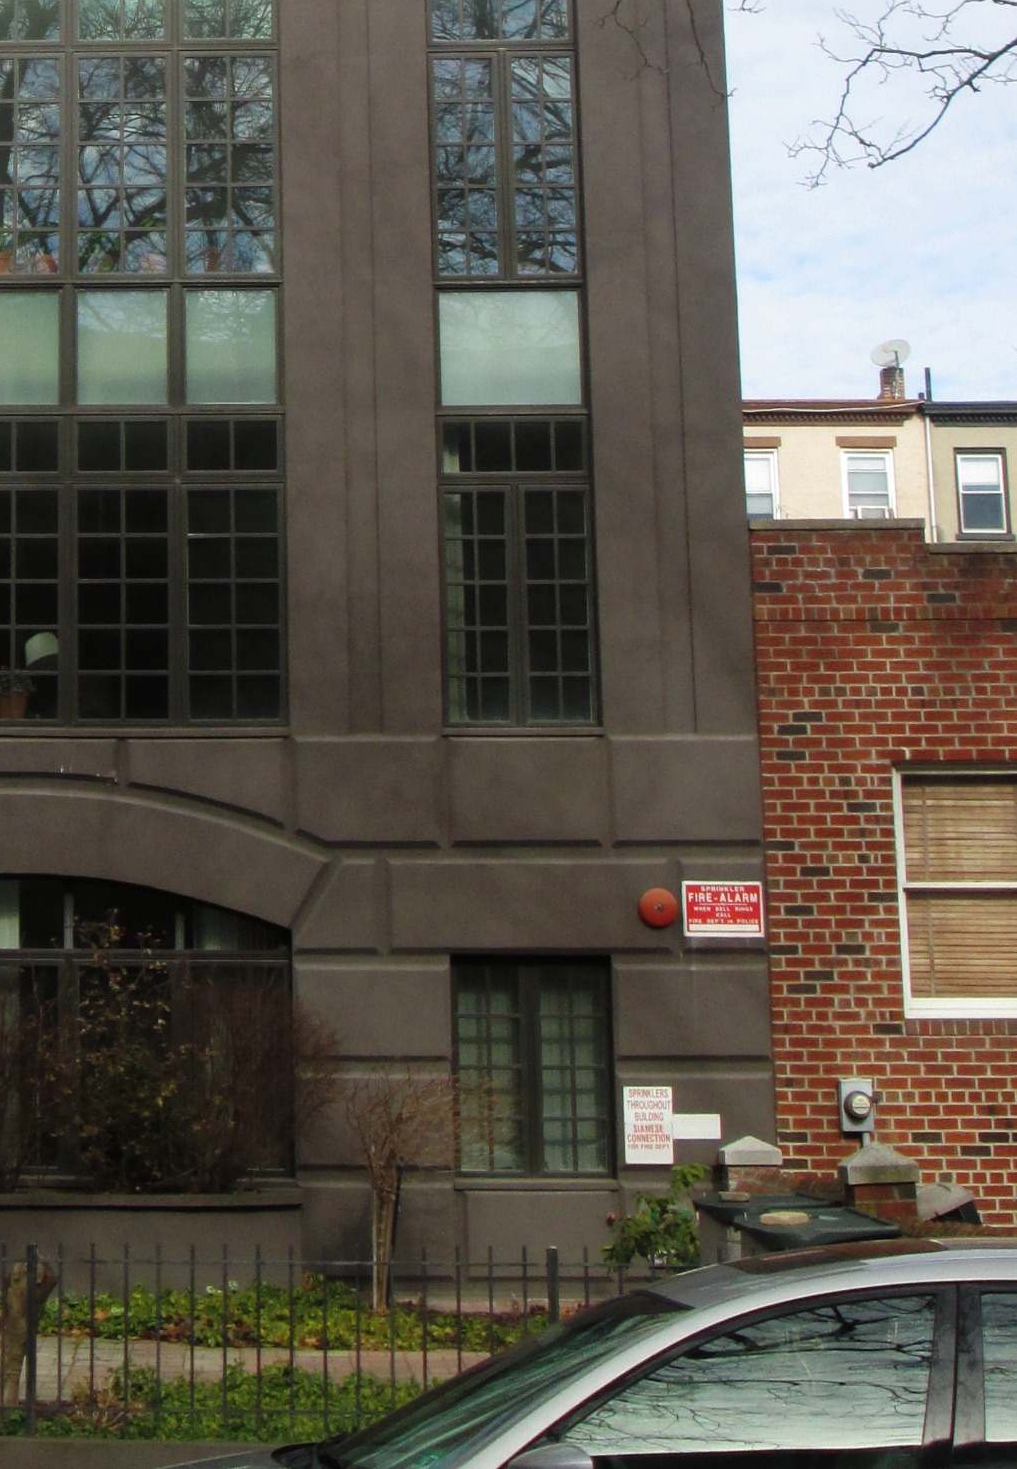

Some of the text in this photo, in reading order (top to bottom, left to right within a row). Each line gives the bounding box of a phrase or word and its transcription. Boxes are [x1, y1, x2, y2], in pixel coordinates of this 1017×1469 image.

[688, 892, 758, 903] FIRE-ALARM
[628, 1089, 669, 1098] SPRINKLERS
[627, 1100, 670, 1110] THROUGHOUT
[634, 1112, 664, 1121] BUILDING
[633, 1124, 663, 1133] SIAMESE
[627, 1134, 670, 1143] CONNECTION
